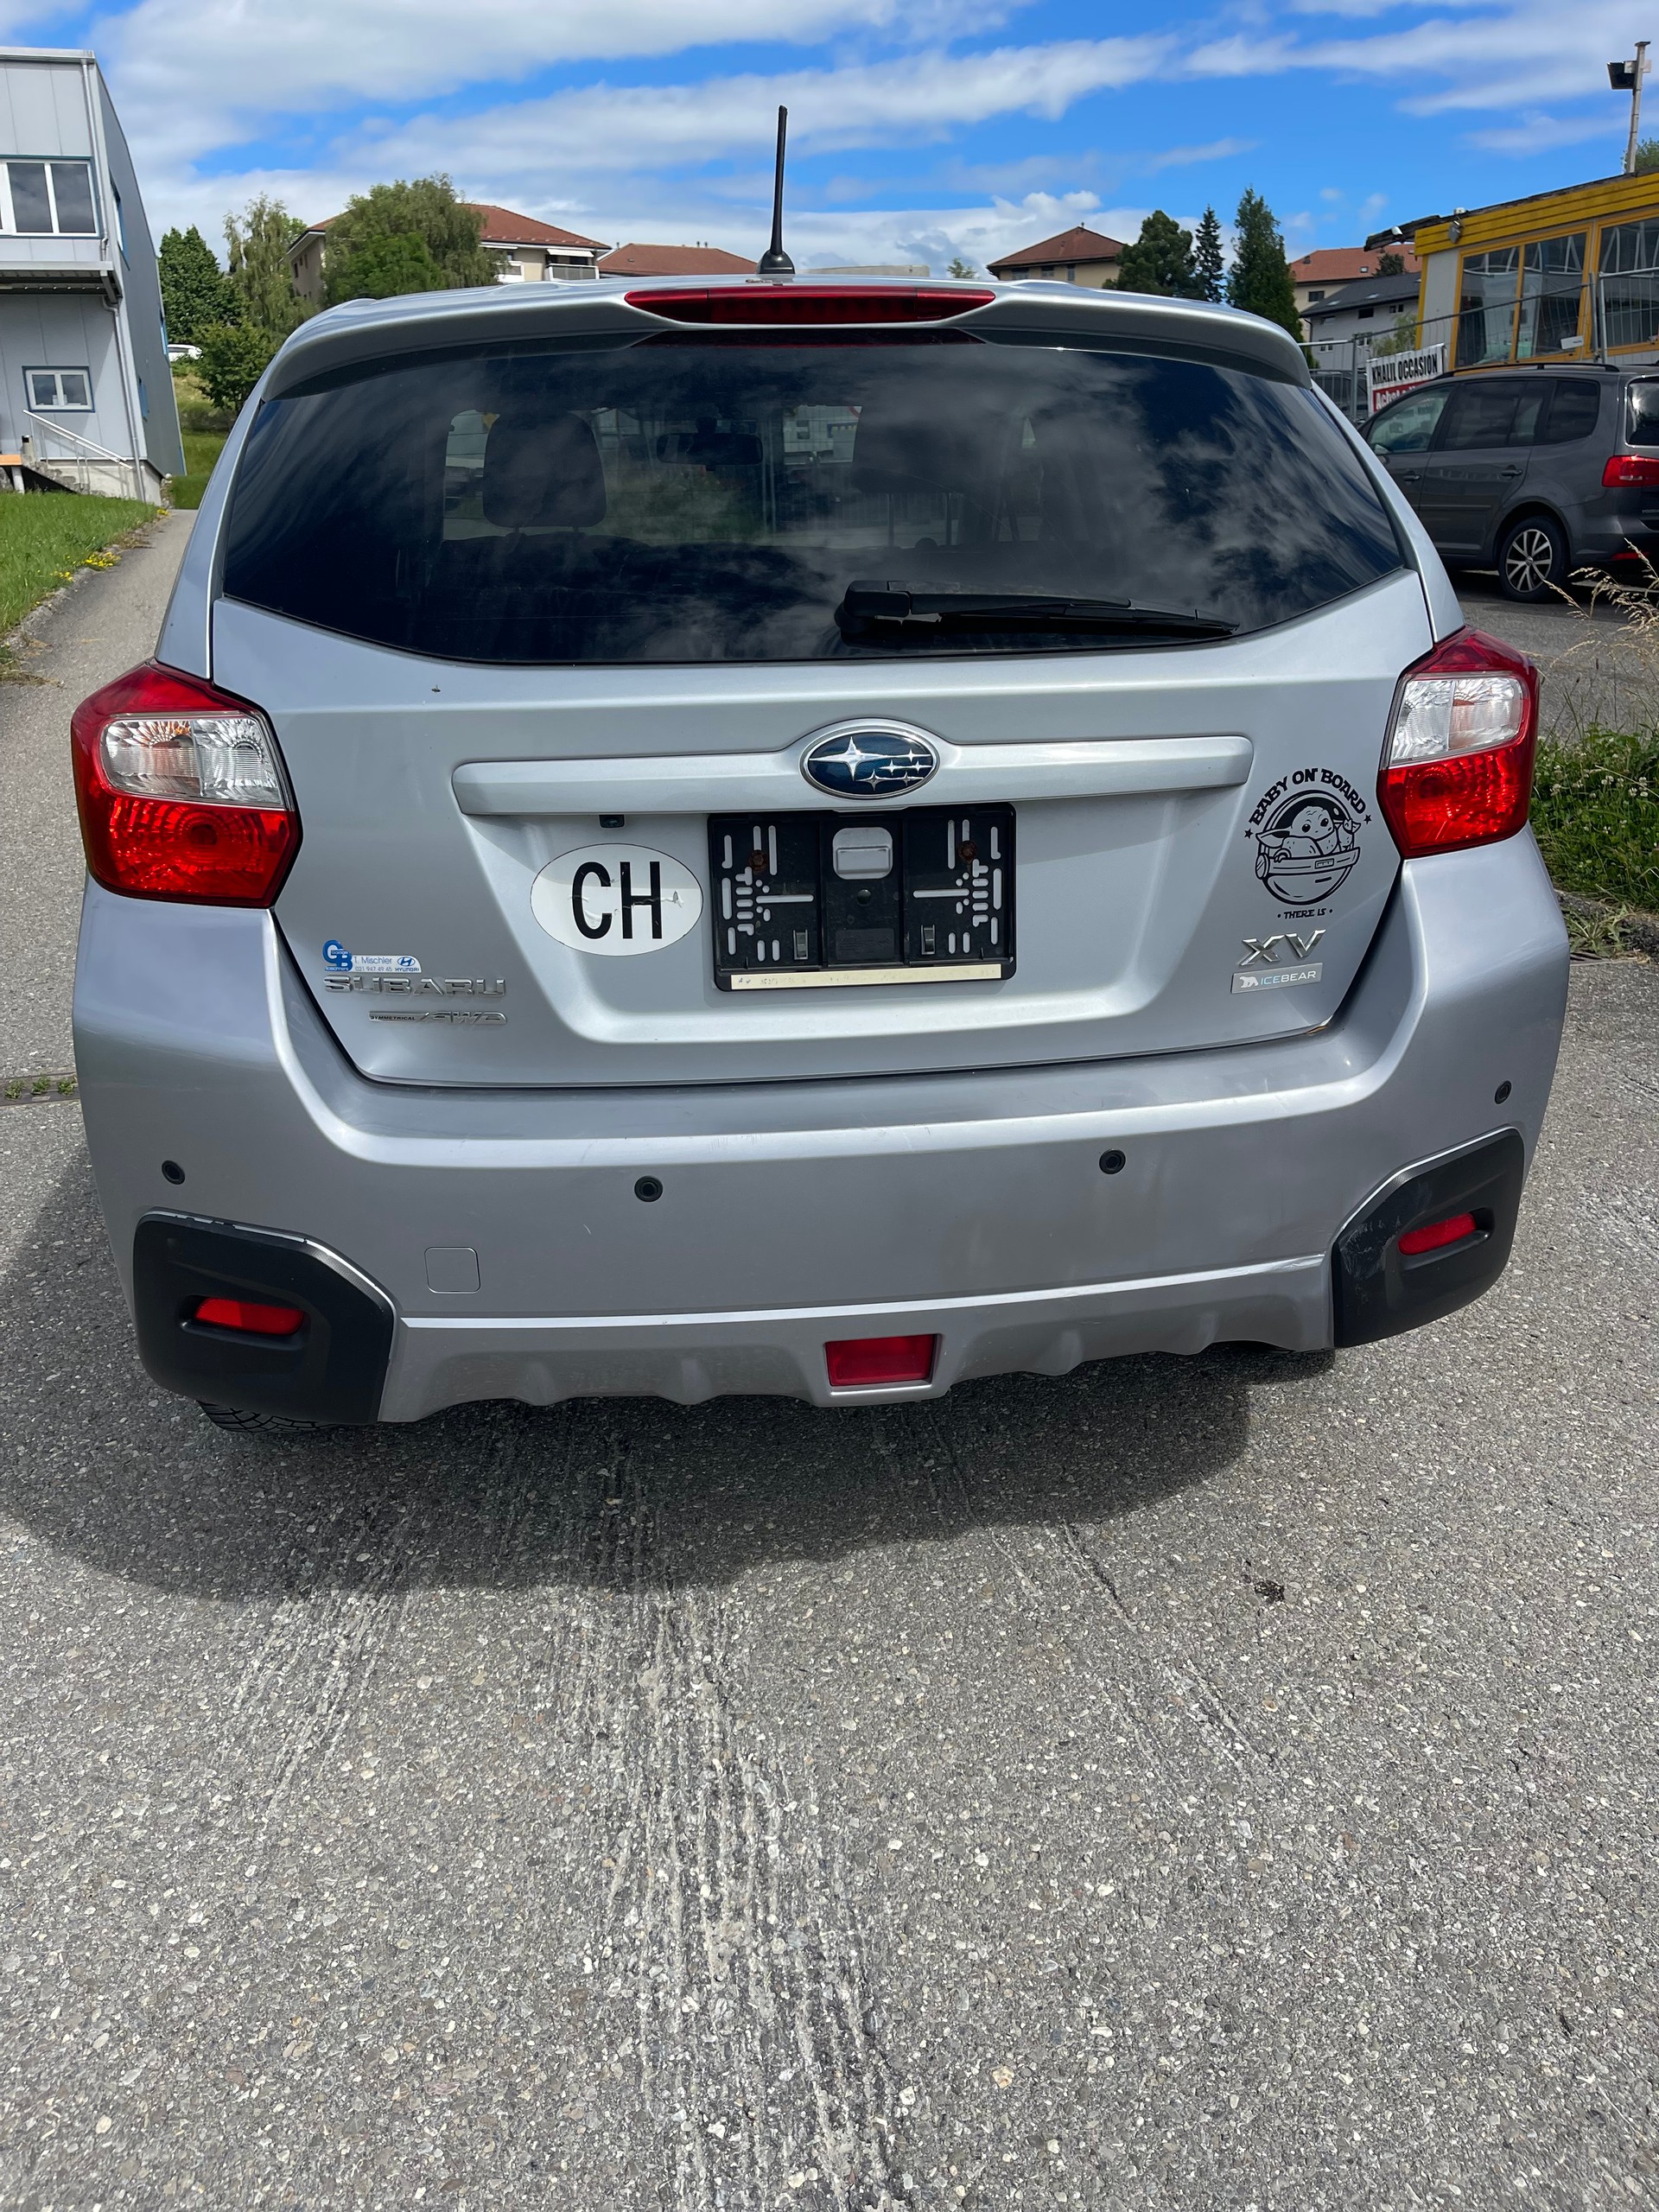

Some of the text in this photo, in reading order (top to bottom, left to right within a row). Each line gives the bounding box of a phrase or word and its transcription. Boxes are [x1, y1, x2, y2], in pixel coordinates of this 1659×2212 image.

[1371, 353, 1438, 385] KHALIL OCCASION
[1249, 767, 1367, 827] BABY ON BOARD
[572, 861, 662, 939] CH
[1283, 908, 1327, 919] THERE IS
[1239, 929, 1326, 966] XV
[361, 956, 392, 965] Mischler
[323, 976, 506, 996] SUBARU
[1261, 970, 1317, 985] ICEBEAR
[431, 1011, 508, 1025] AWD
